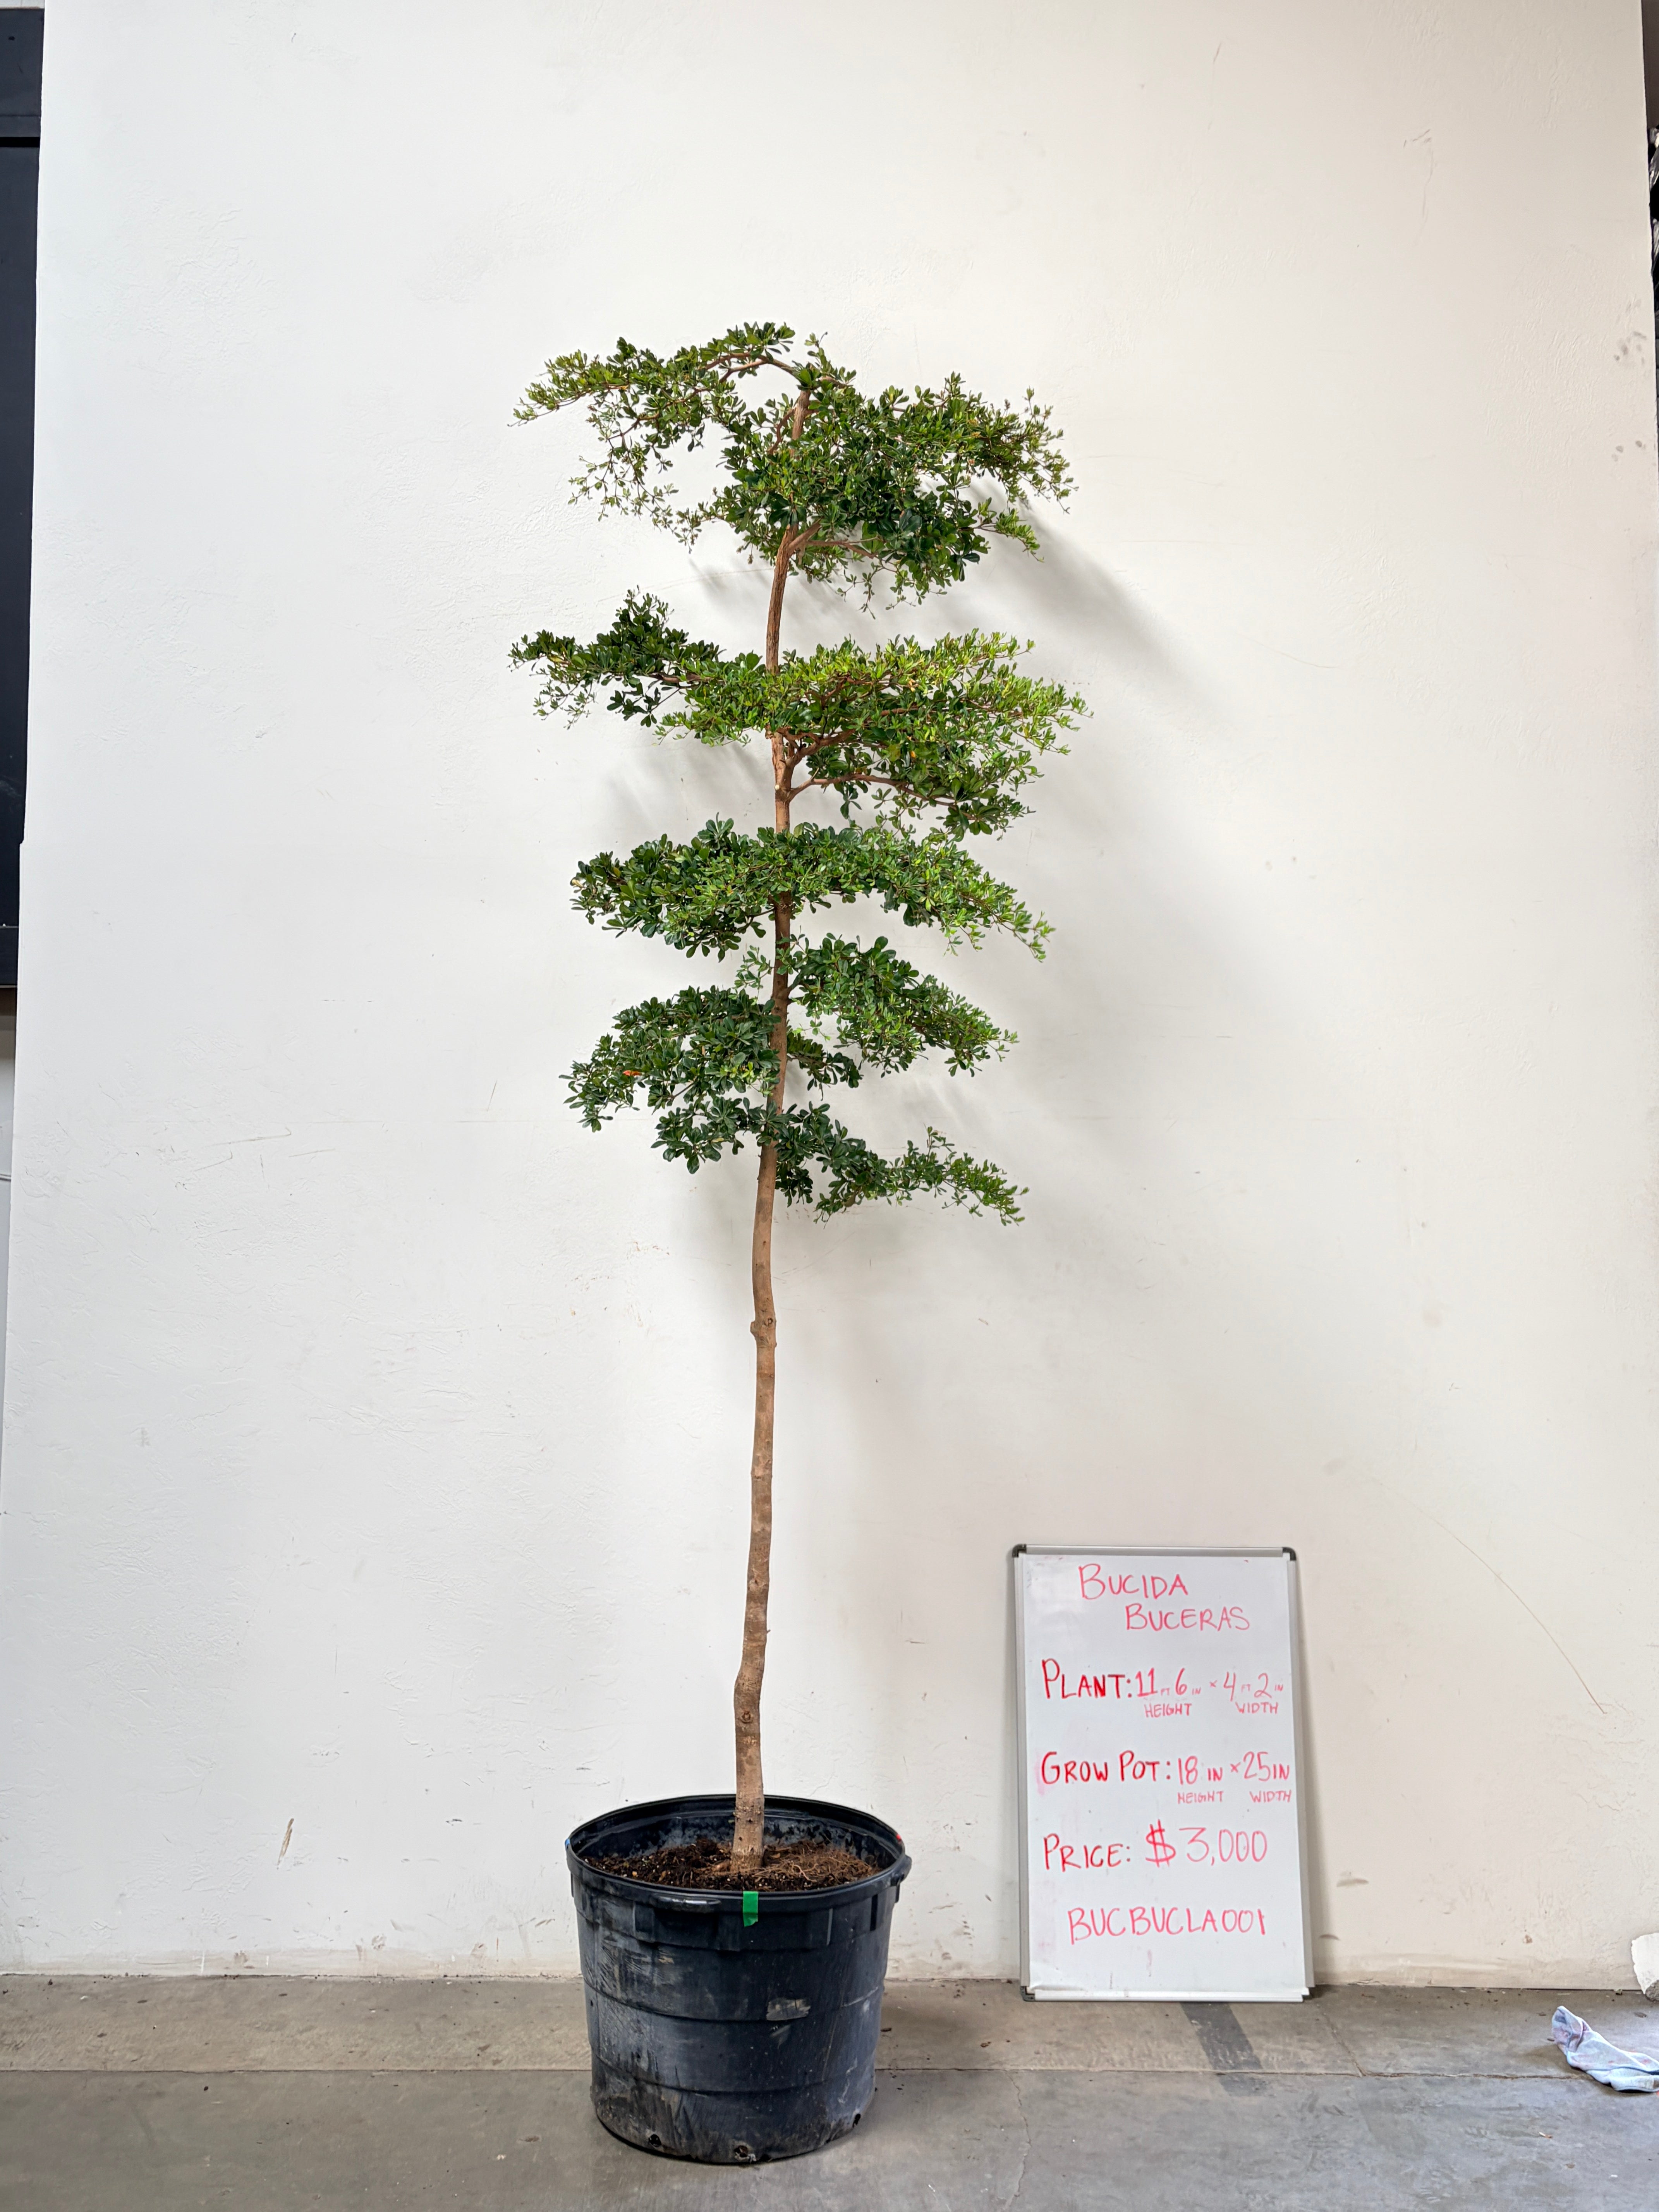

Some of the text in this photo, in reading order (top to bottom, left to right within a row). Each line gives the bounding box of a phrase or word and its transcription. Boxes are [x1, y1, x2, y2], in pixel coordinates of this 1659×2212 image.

[1077, 1563, 1188, 1601] BUCIDA
[1124, 1602, 1250, 1632] BUCERAS
[1041, 1658, 1132, 1700] PLANT:
[1135, 1667, 1158, 1695] 11
[1174, 1668, 1188, 1696] 6
[1223, 1672, 1237, 1702] 4
[1253, 1673, 1272, 1698] 2
[1144, 1701, 1279, 1718] HEIGHT WIDTH
[1041, 1751, 1109, 1785] GROW
[1118, 1750, 1171, 1783] POT:
[1177, 1755, 1199, 1786] 18
[1177, 1790, 1292, 1804] HEIGHT WIDTH
[1043, 1833, 1131, 1873] PRICE:
[1067, 1906, 1266, 1946] BUCBUCLA001
